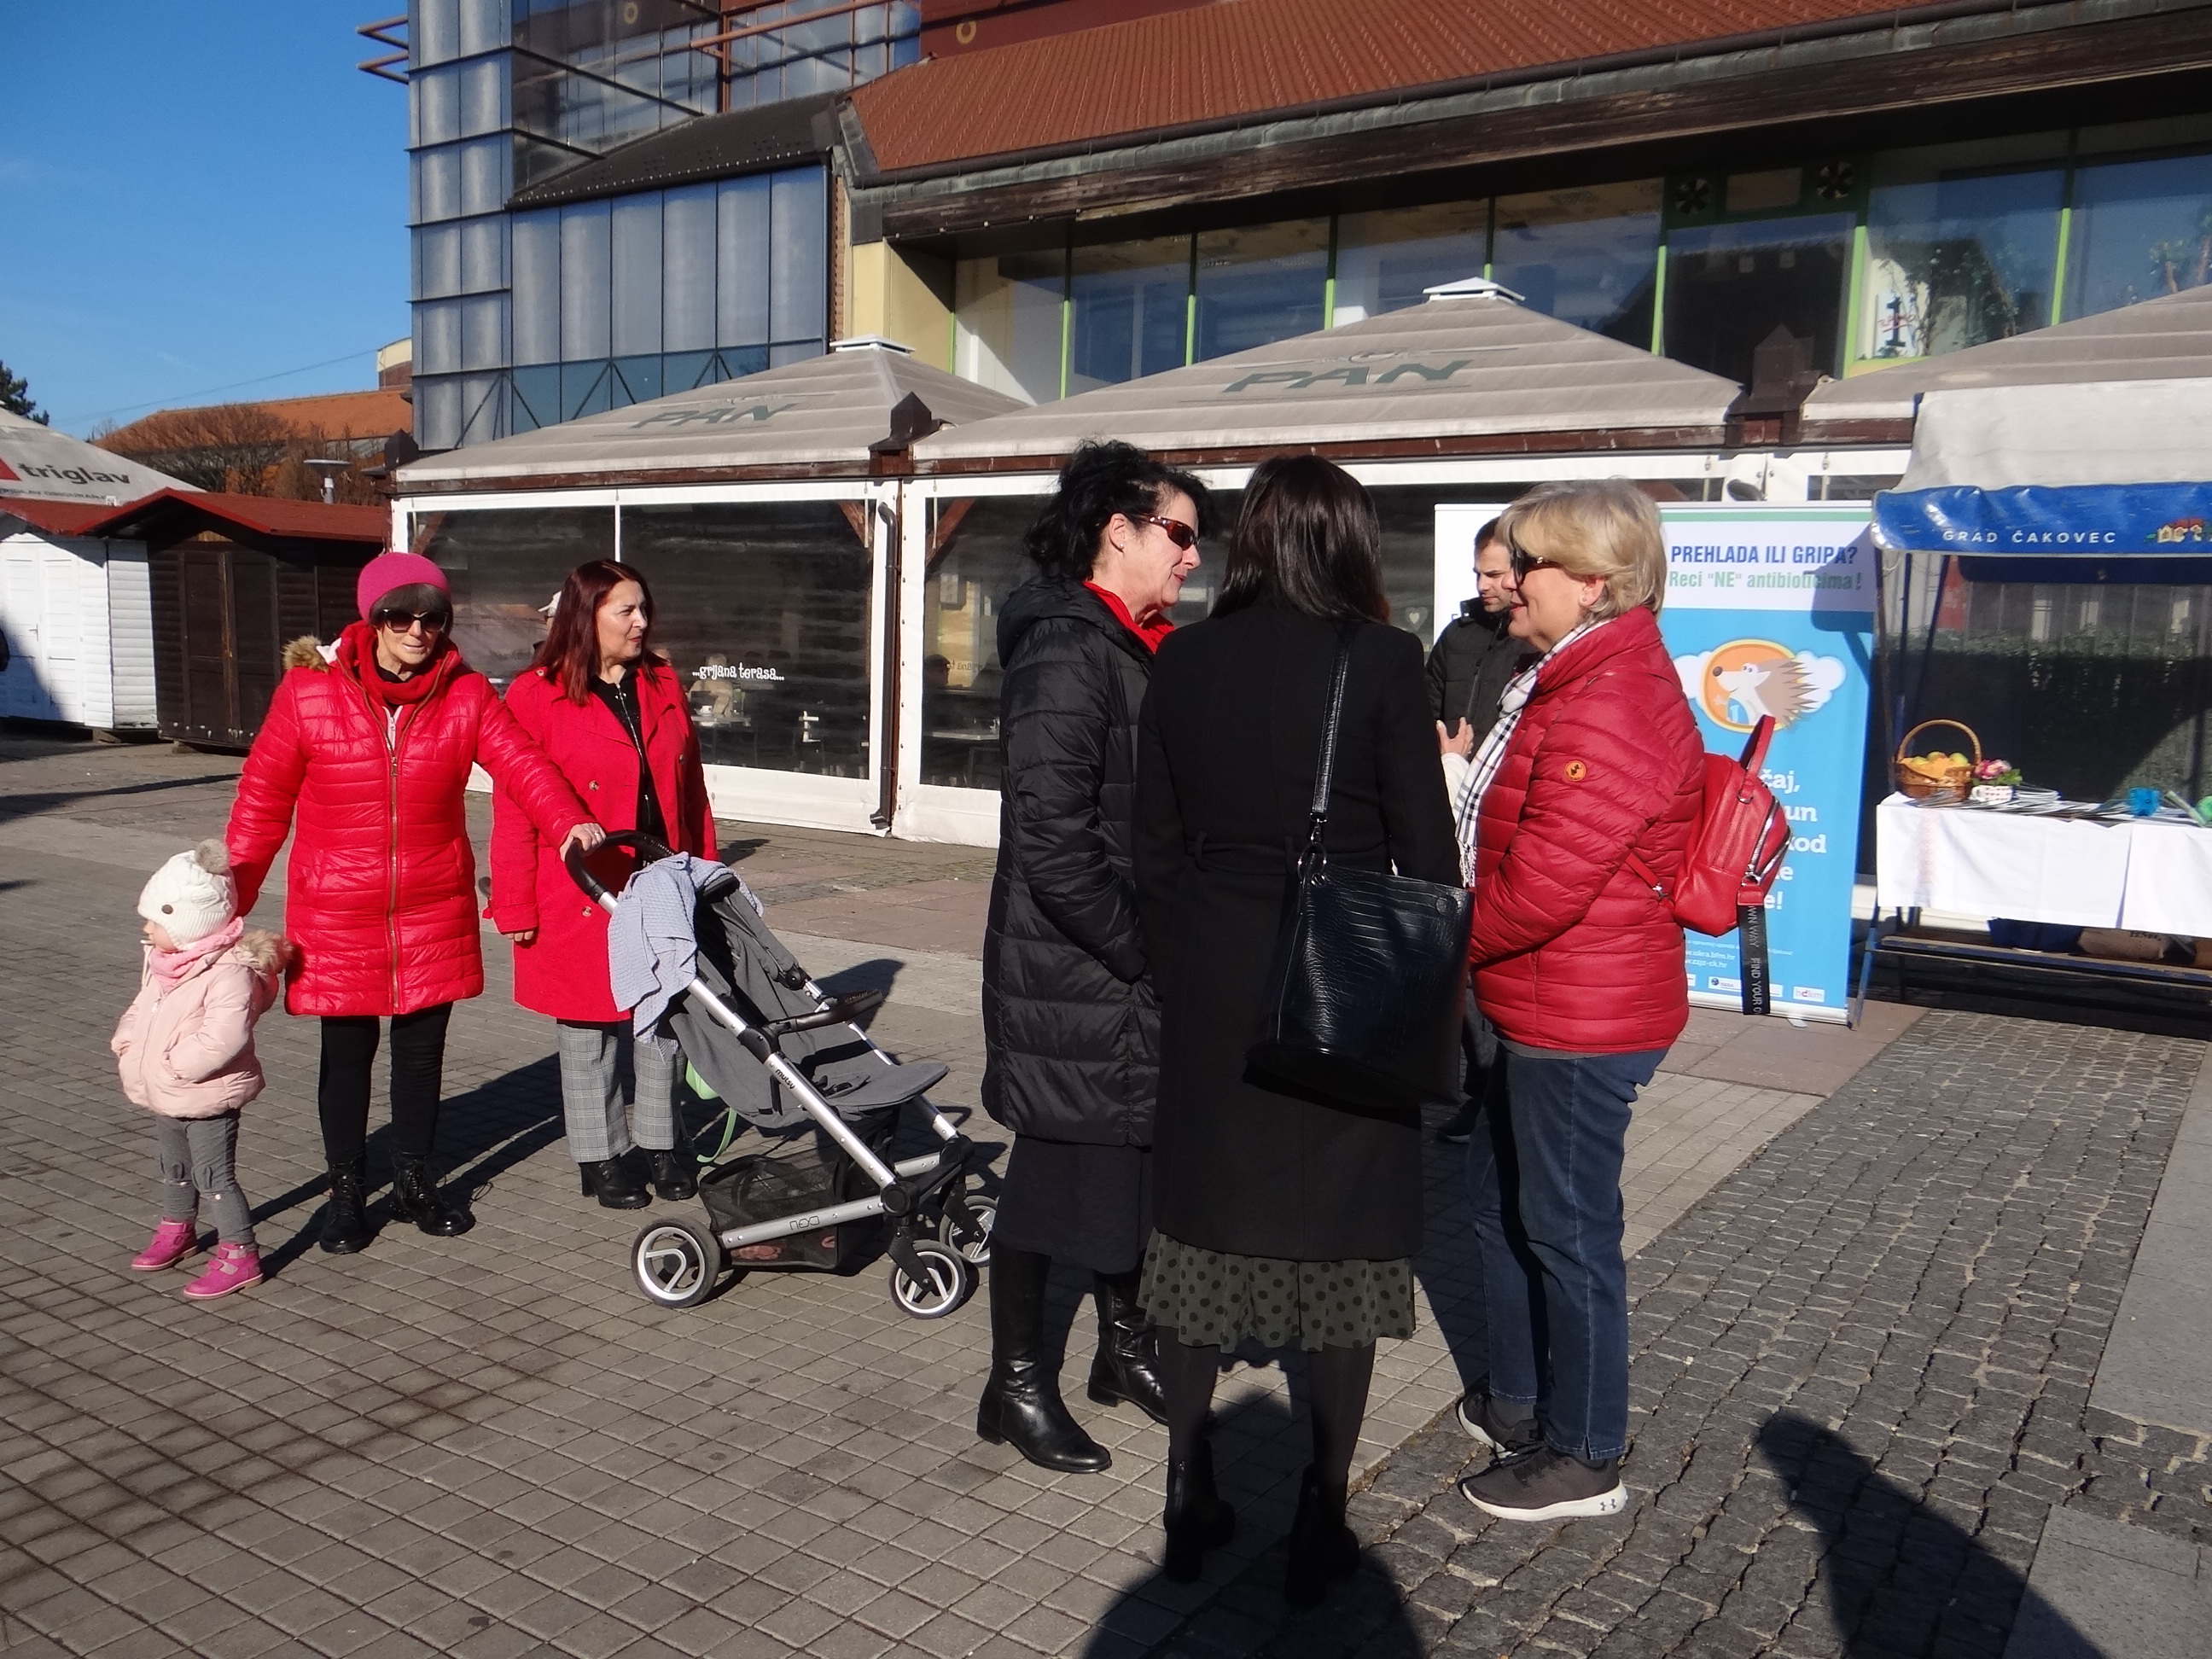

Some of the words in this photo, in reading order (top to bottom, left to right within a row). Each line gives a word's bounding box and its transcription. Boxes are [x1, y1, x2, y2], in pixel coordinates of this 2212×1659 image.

[1222, 359, 1473, 393] PAN
[629, 402, 800, 428] PAN
[18, 463, 130, 485] triglav
[1941, 530, 1999, 543] GRAD
[2011, 529, 2116, 544] ČAKOVEC
[1670, 545, 1759, 563] PREHLADA
[1765, 545, 1786, 563] ILI
[1792, 546, 1859, 564] GRIPA?
[1668, 570, 1703, 587] Reci
[1748, 925, 1760, 947] WAY
[1749, 958, 1761, 979] FIND
[1751, 981, 1763, 1005] YOUR
[775, 1068, 796, 1090] mutsy
